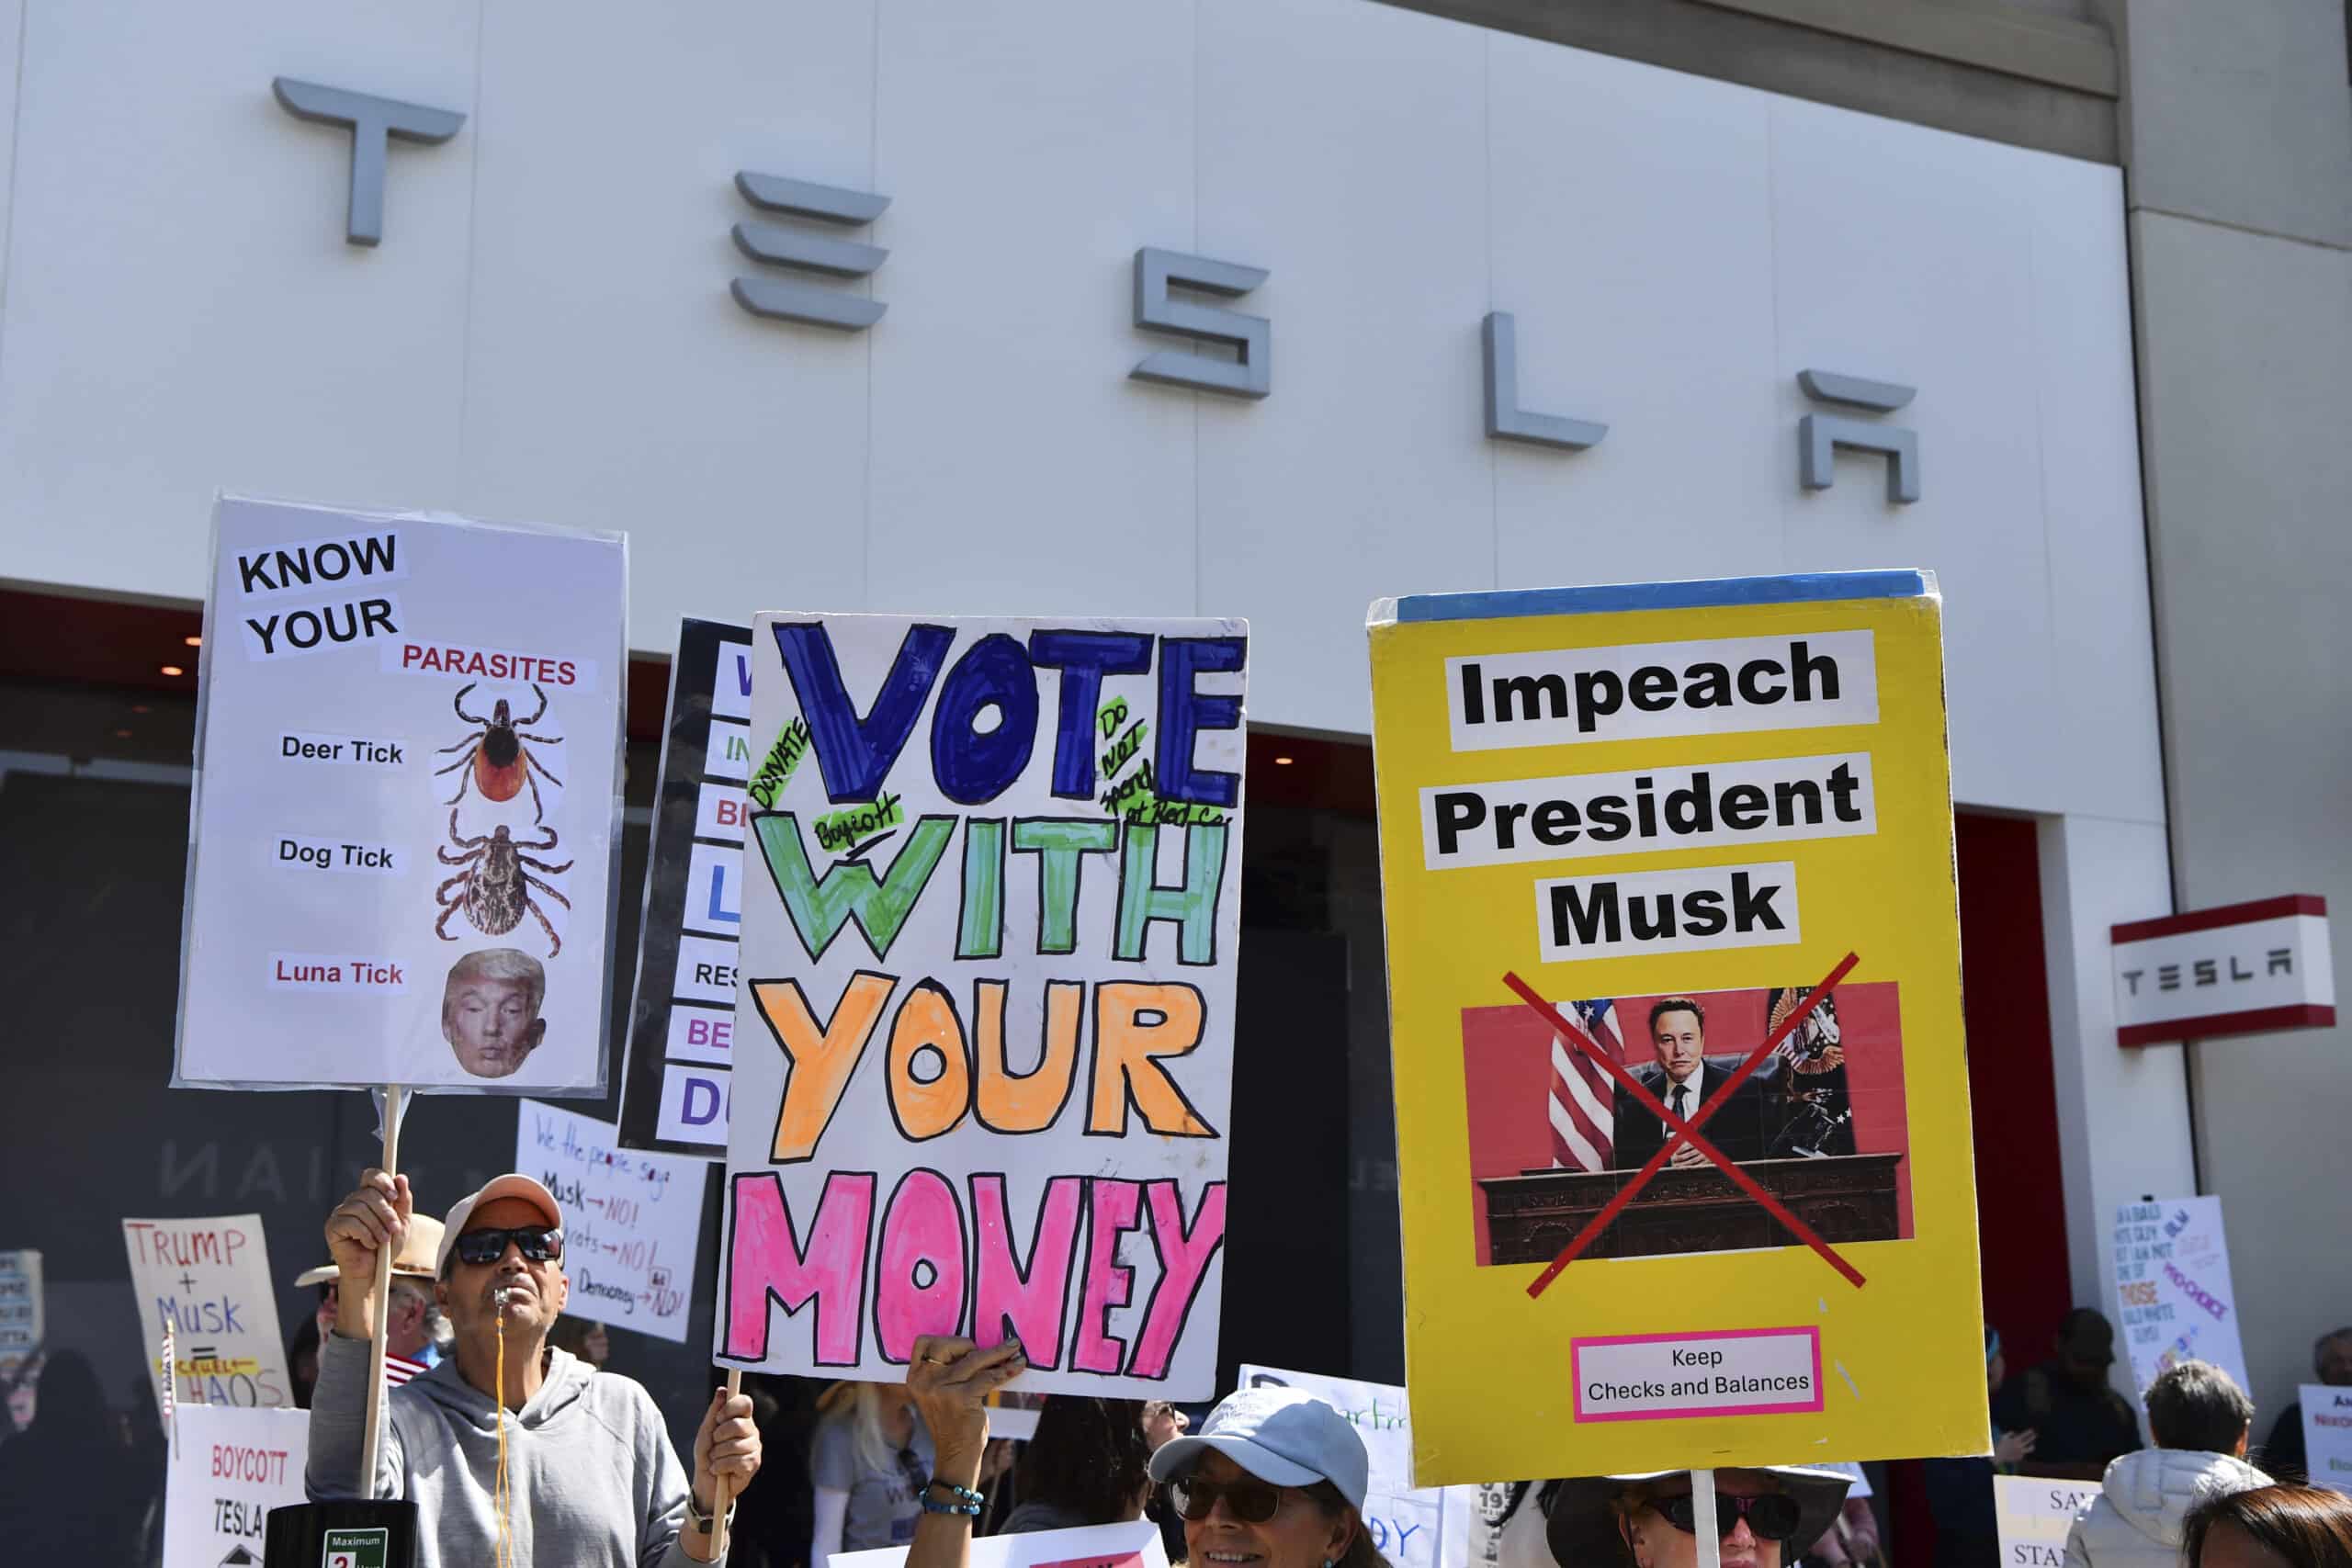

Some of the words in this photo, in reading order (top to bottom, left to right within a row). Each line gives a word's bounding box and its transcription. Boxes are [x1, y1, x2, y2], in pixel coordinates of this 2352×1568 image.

[273, 75, 1920, 504] TESLA
[238, 535, 395, 593] KNOW
[246, 598, 399, 655] YOUR
[402, 645, 577, 686] PARASITES
[1462, 641, 1839, 733] Impeach
[772, 621, 1248, 808] VOTE
[283, 737, 343, 761] Deer
[351, 741, 403, 764] Tick
[750, 716, 811, 812] DONATE
[1102, 718, 1144, 775] NOT
[815, 791, 901, 851] Boycott
[1434, 762, 1862, 855] President
[279, 840, 331, 868] Dog
[342, 844, 393, 868] Tick
[751, 812, 1230, 966] WITH
[1550, 872, 1785, 946] Musk
[277, 960, 341, 983] Luna
[351, 962, 403, 985] Tick
[2121, 948, 2293, 997] TESLA
[750, 971, 1219, 1164] YOUR
[560, 1120, 584, 1162] the
[588, 1145, 633, 1179] people
[542, 1170, 585, 1212] Musk
[605, 1196, 639, 1228] NO!
[127, 1223, 245, 1266] TRUMP
[722, 1168, 1227, 1380] MONEY
[1672, 1348, 1723, 1369] Keep
[187, 1368, 284, 1407] HAOS
[1589, 1381, 1665, 1401] Checks
[1671, 1377, 1709, 1397] and
[1715, 1374, 1809, 1394] Balances
[212, 1444, 288, 1484] BOYCOTT
[214, 1498, 263, 1540] TESLA
[332, 1536, 380, 1547] Maximum
[2014, 1543, 2067, 1567] STA
